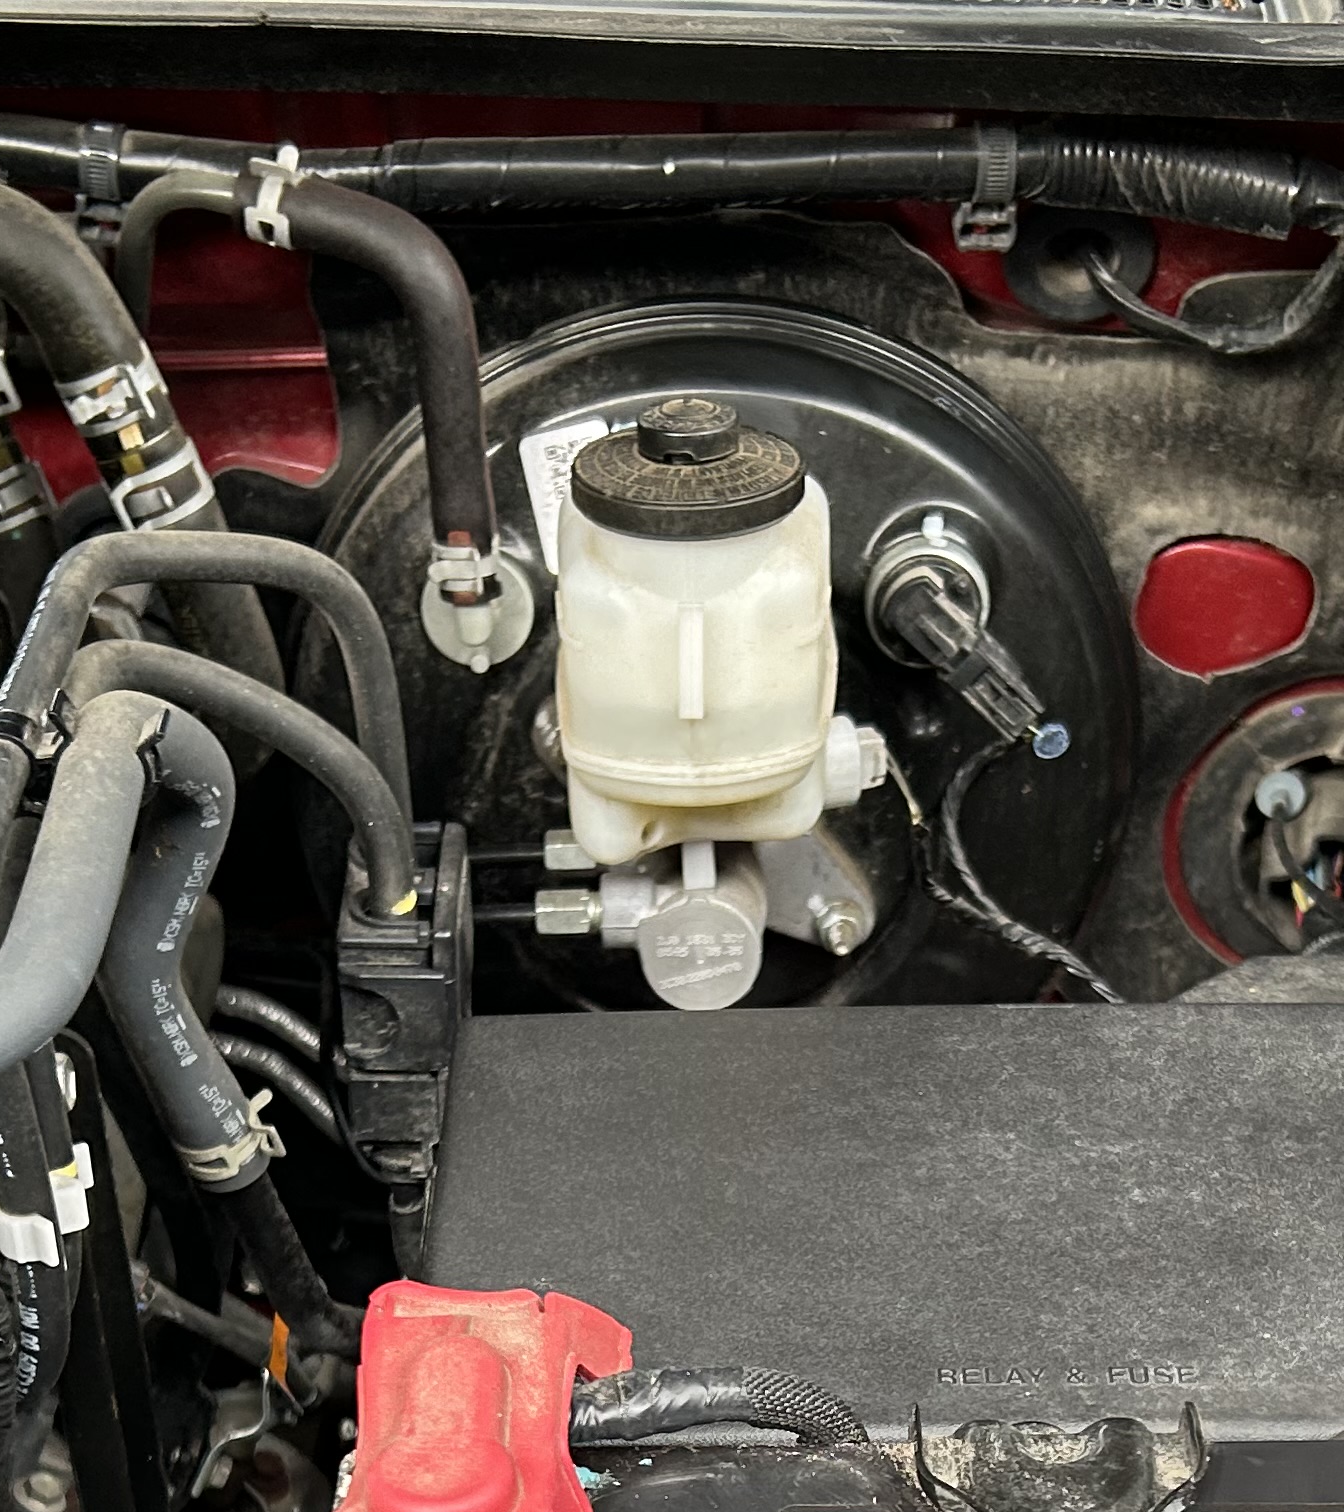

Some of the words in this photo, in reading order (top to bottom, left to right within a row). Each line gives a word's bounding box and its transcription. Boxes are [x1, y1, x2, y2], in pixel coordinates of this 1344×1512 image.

[937, 1366, 1045, 1386] RELAY
[1066, 1367, 1086, 1384] &
[1108, 1366, 1199, 1386] FUSE
